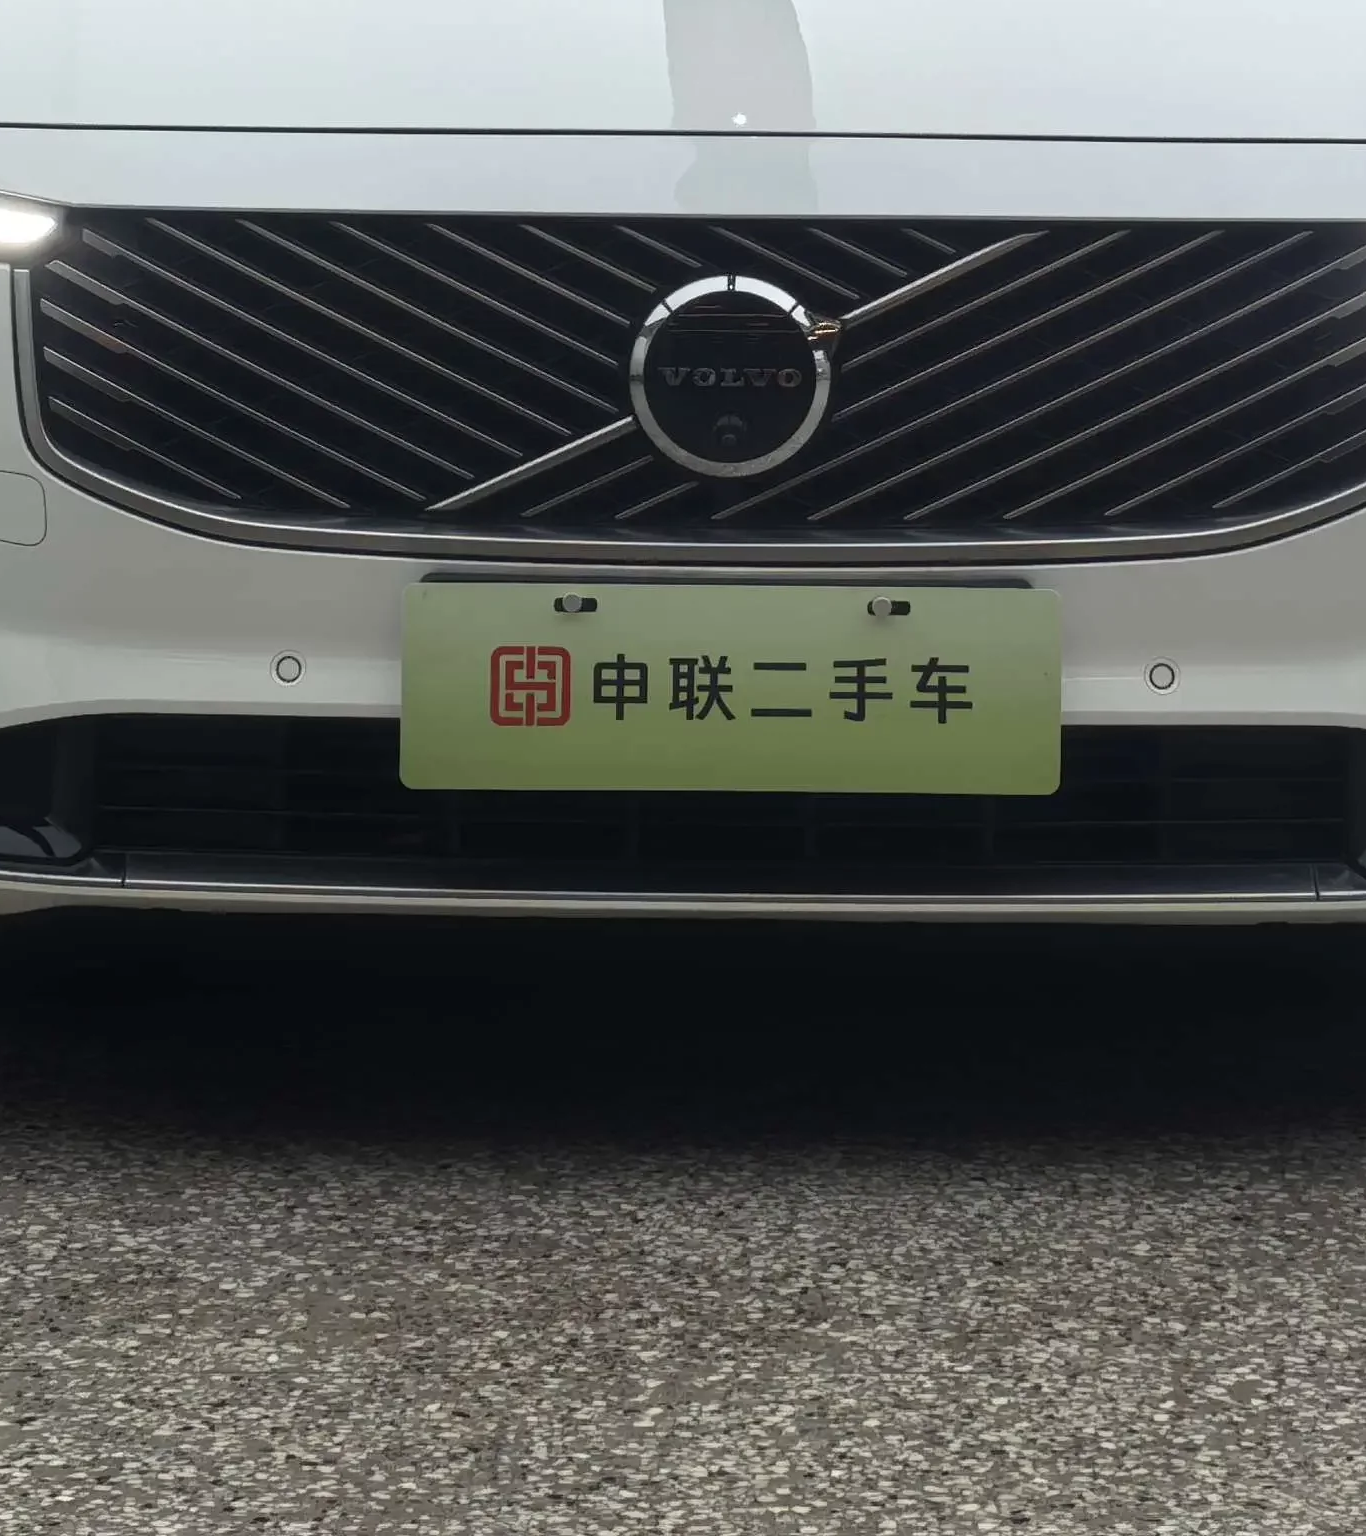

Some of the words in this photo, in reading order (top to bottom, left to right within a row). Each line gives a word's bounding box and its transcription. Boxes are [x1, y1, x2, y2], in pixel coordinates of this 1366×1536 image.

[658, 367, 803, 387] VOLVO
[593, 653, 973, 724] 申联二手车
